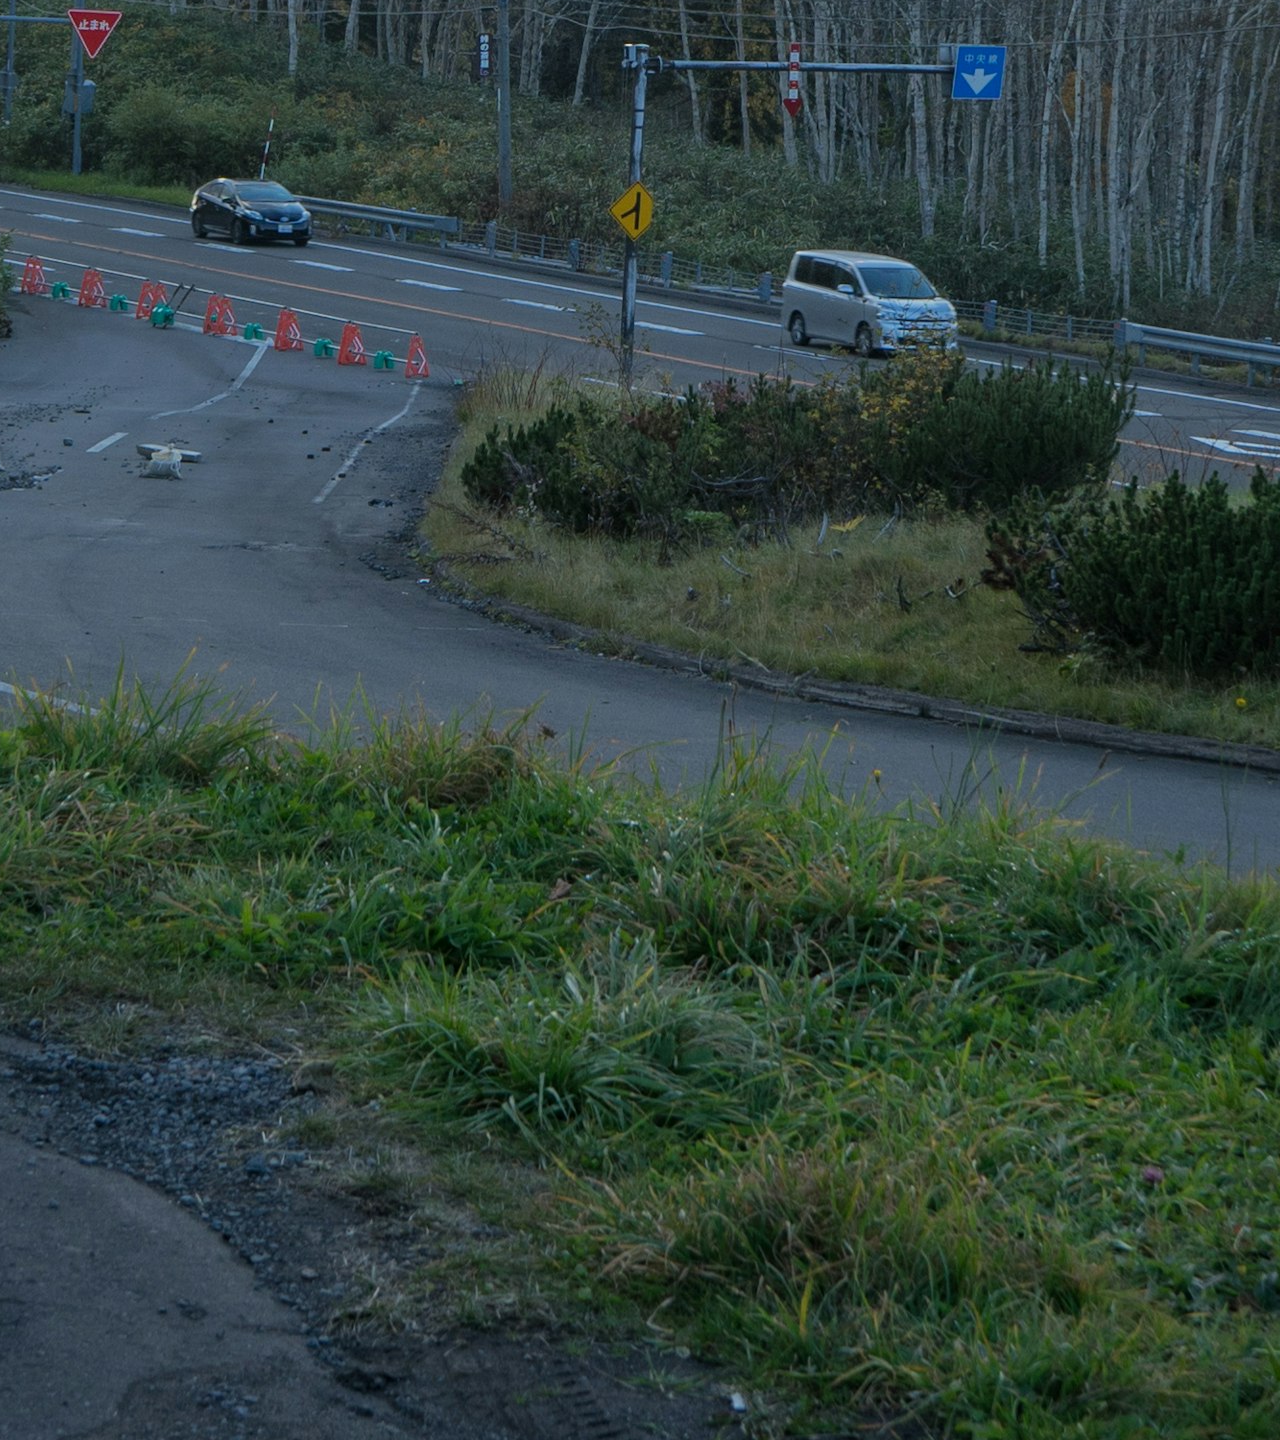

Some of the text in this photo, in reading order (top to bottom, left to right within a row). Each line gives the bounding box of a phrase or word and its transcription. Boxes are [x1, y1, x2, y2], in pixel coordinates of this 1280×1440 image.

[78, 19, 111, 31] 止まれ
[964, 53, 998, 65] 中央線
